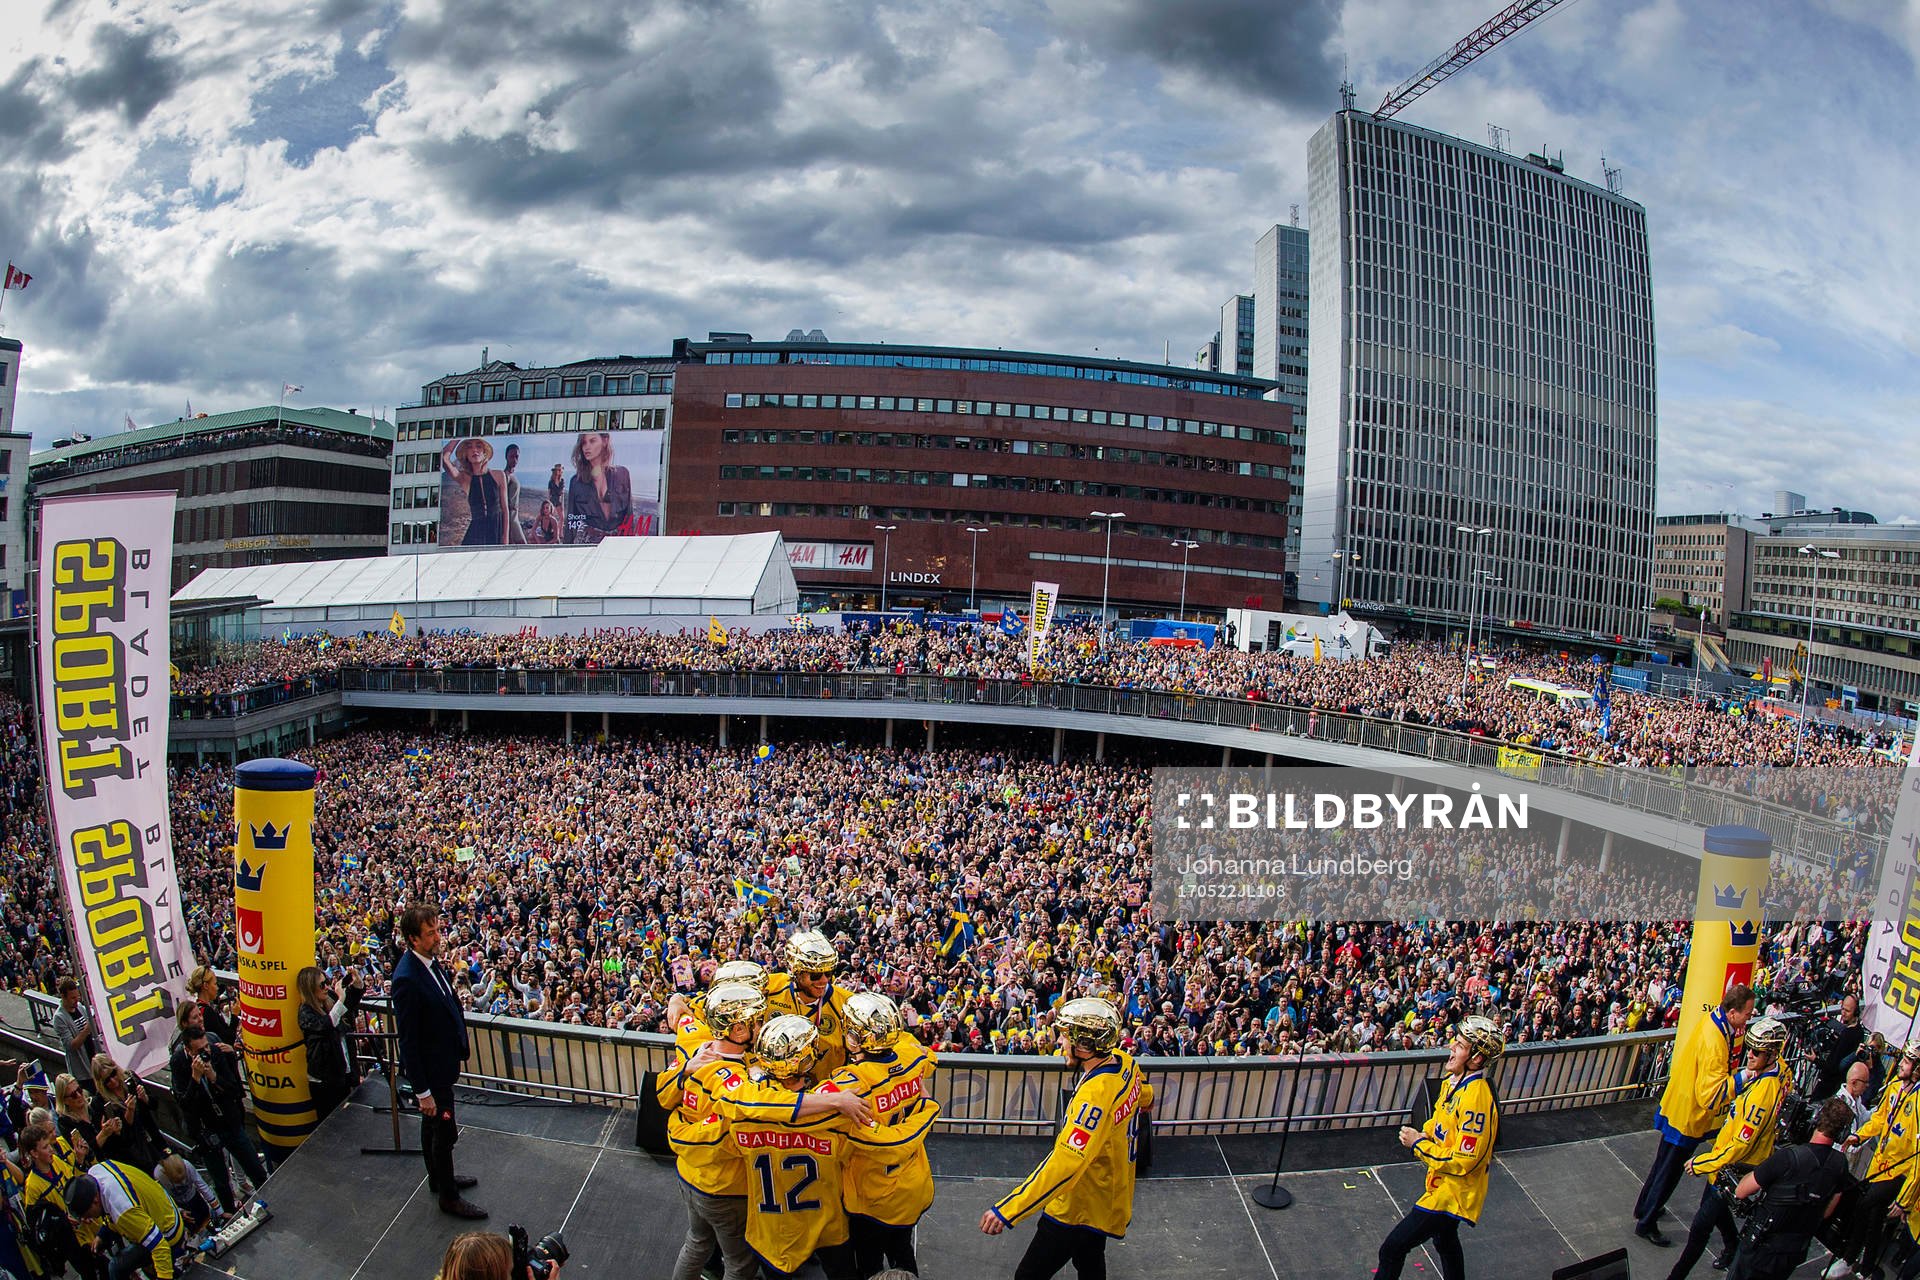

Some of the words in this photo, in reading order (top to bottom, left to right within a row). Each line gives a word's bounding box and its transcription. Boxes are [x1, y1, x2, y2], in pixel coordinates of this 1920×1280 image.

[838, 546, 868, 566] H&M
[890, 571, 942, 584] LINDEX
[1354, 601, 1384, 612] MANGO
[260, 960, 288, 971] SPEL
[248, 1069, 296, 1089] KODA
[1073, 1102, 1103, 1131] 18
[1462, 1110, 1486, 1134] 29
[1745, 1104, 1766, 1127] 15
[737, 1132, 831, 1152] BAUHAUS
[753, 1153, 821, 1215] 12
